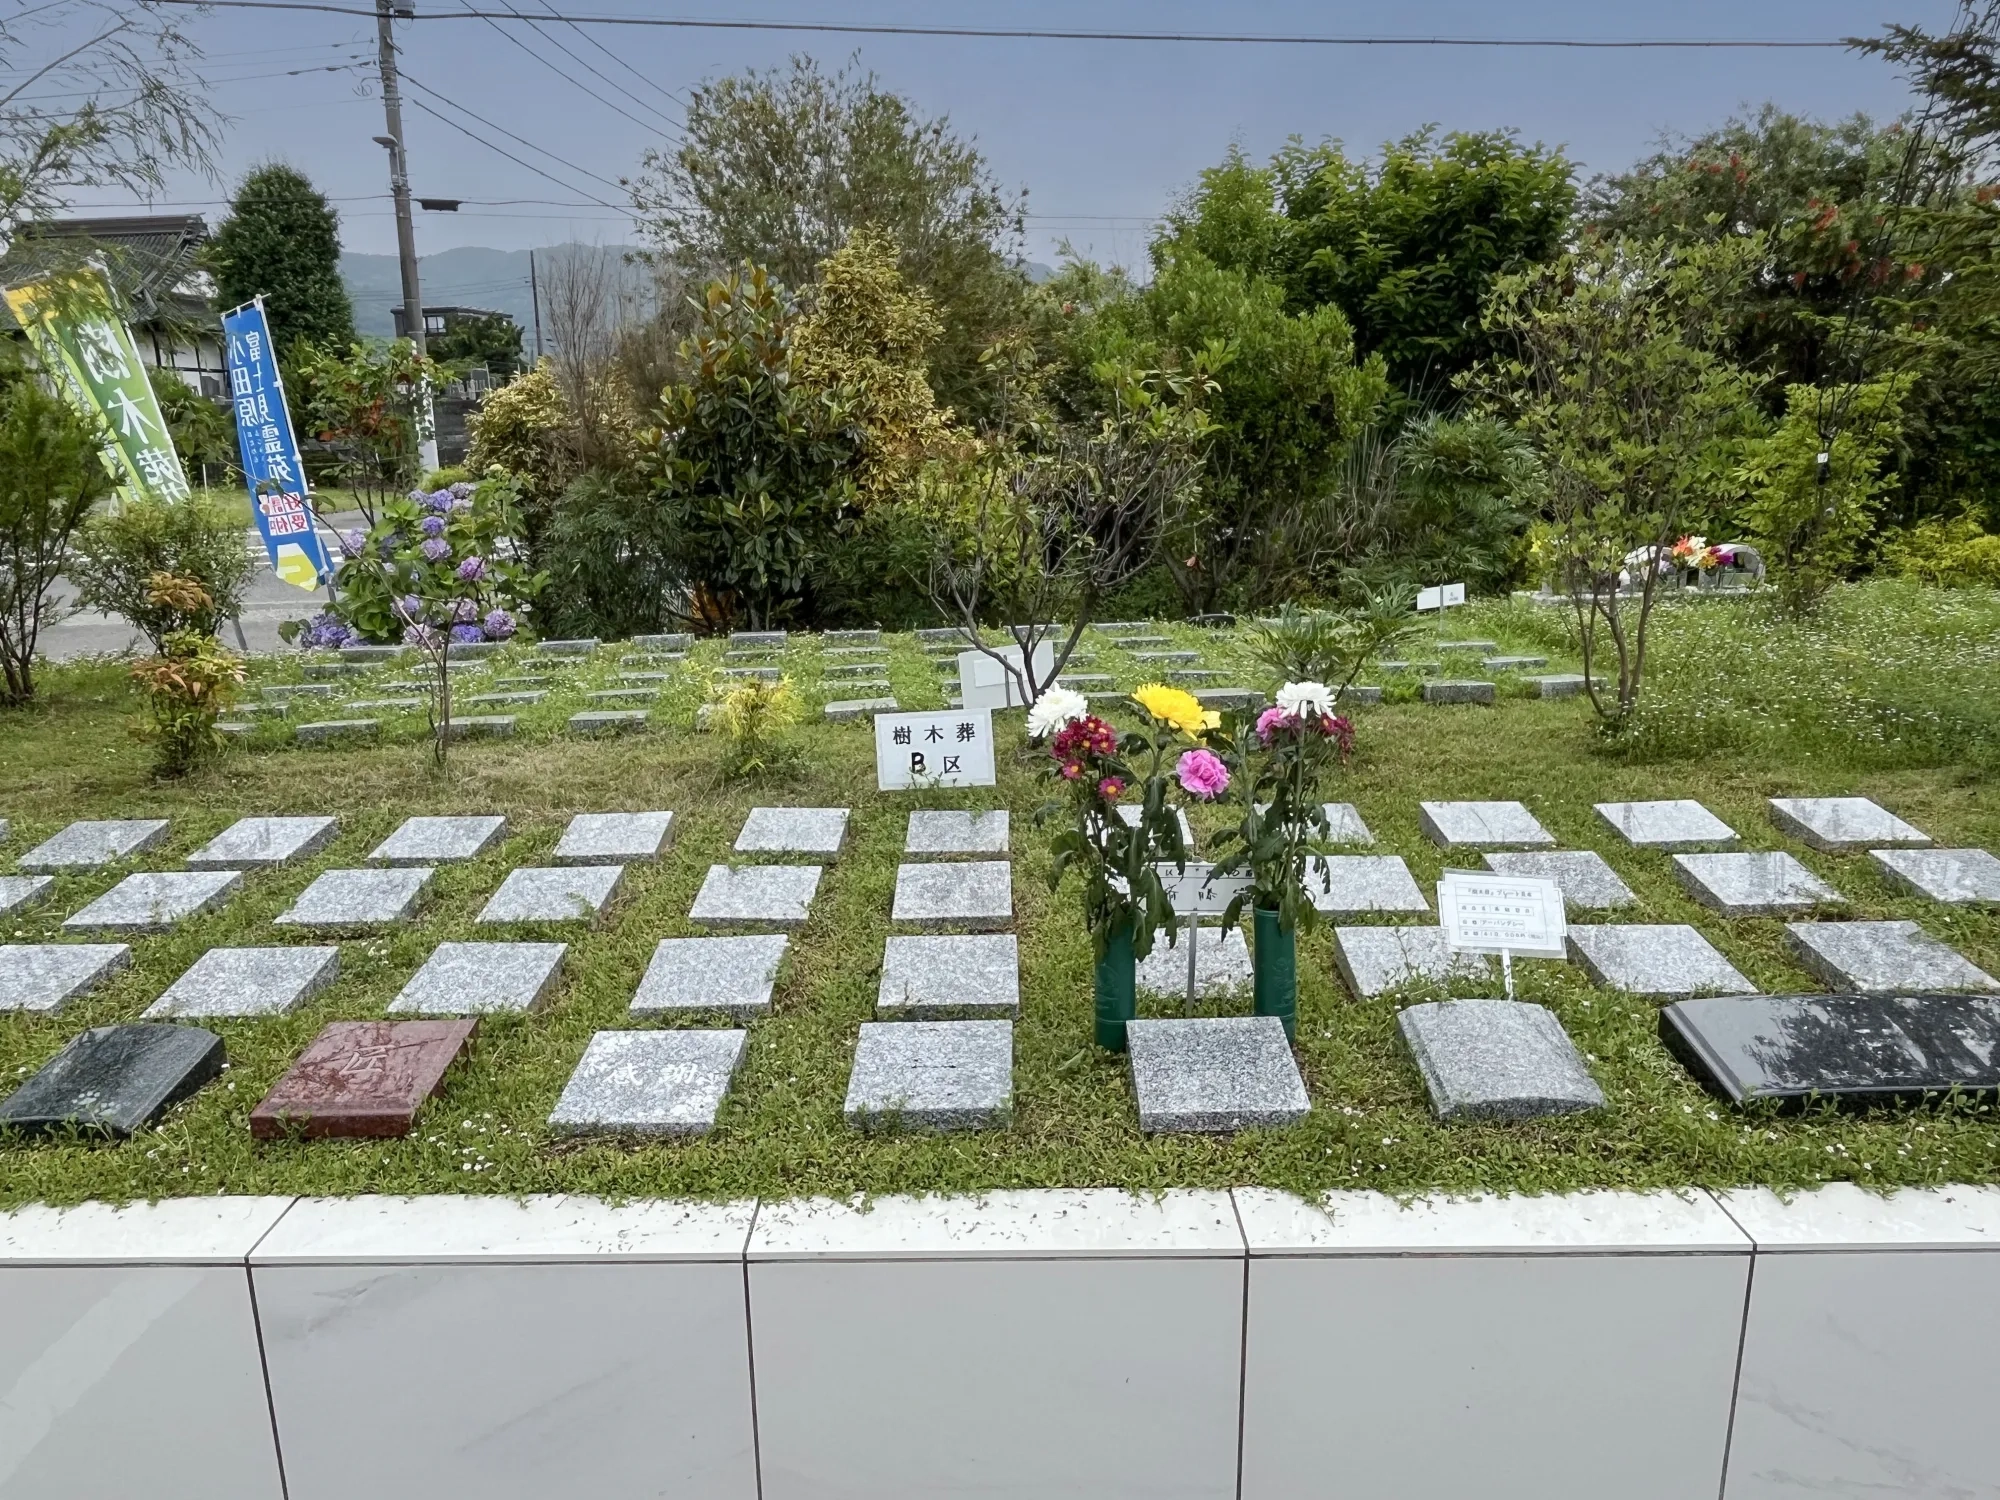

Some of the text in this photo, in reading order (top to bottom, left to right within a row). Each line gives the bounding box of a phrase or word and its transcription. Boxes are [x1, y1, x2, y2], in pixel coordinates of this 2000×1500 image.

[892, 722, 976, 745] 樹木葬
[603, 1062, 698, 1086] 感謝
